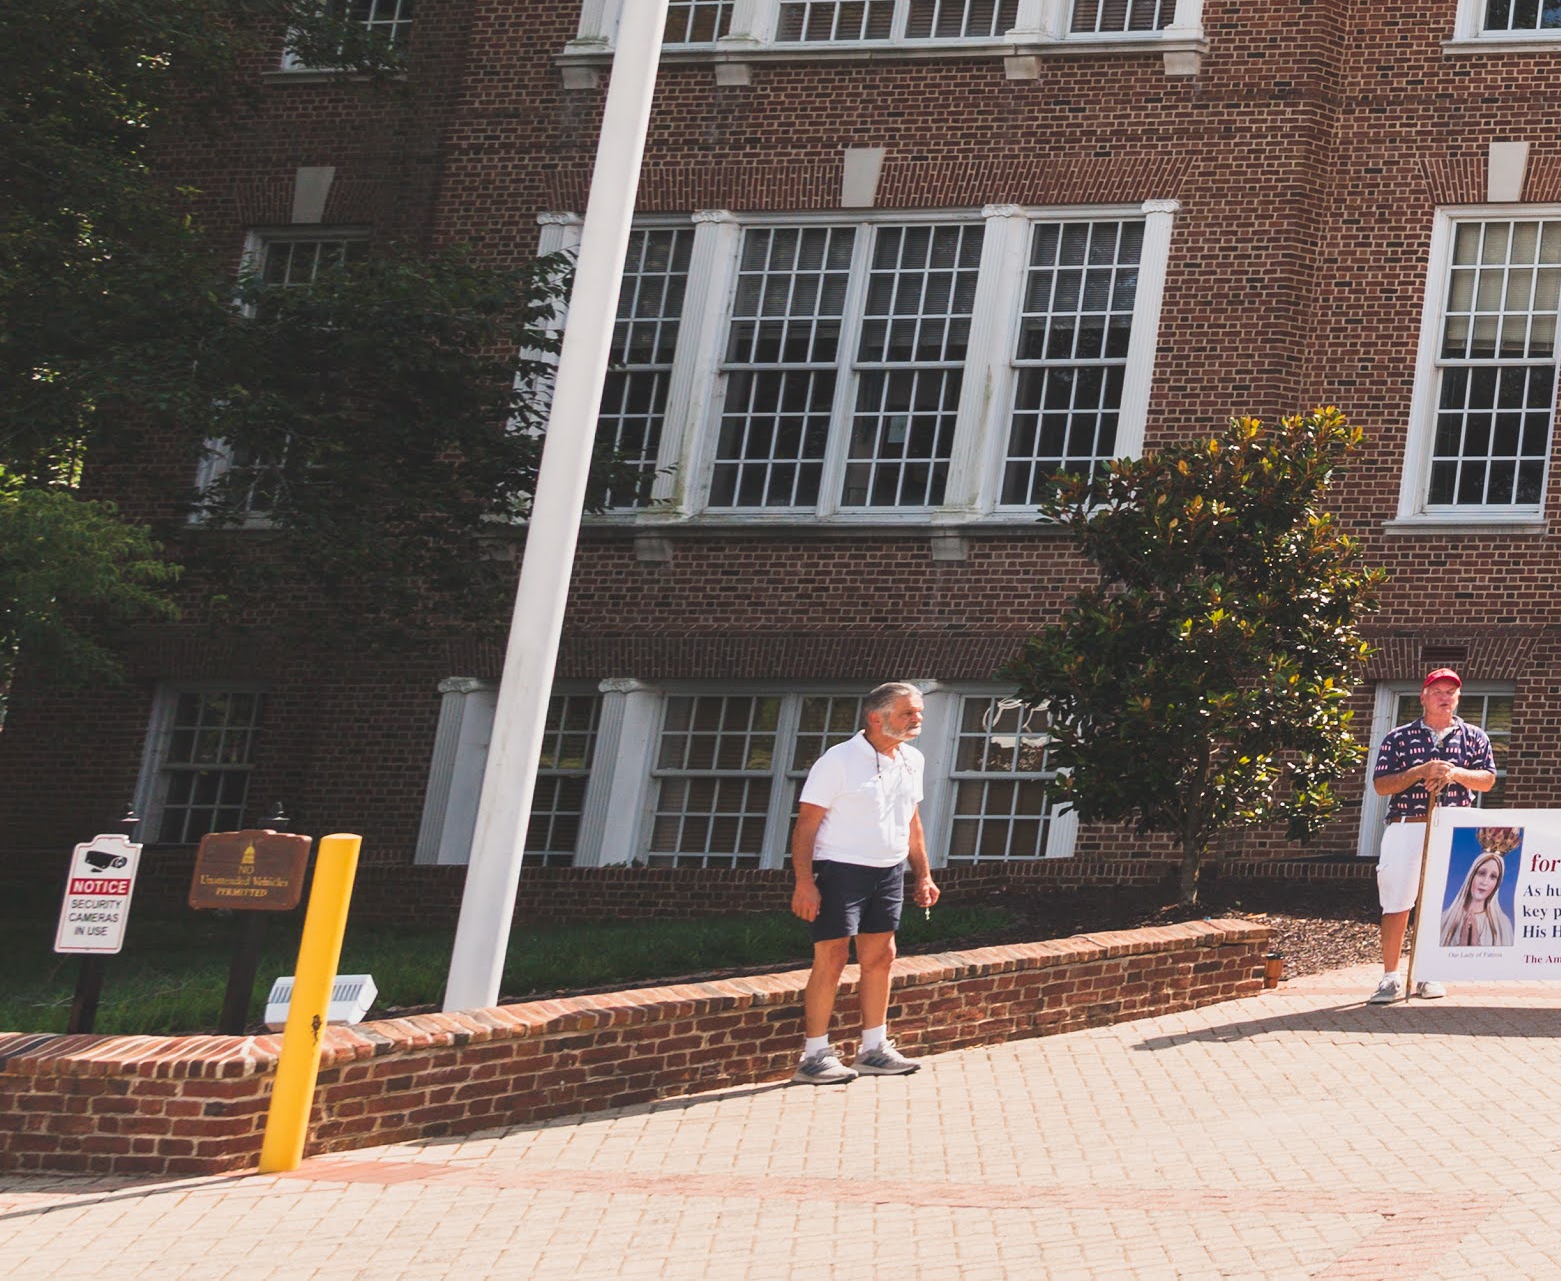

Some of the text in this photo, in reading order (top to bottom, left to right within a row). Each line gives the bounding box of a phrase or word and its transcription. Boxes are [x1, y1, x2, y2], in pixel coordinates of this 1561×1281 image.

[1530, 854, 1561, 872] for
[240, 865, 254, 875] NO
[73, 880, 128, 893] NOTICE
[1523, 885, 1541, 897] As
[72, 899, 122, 909] SECURITY
[69, 913, 119, 922] CAMERAS
[1523, 905, 1548, 919] key
[74, 926, 108, 936] IN USE
[1523, 924, 1547, 938] His
[1524, 954, 1542, 964] The
